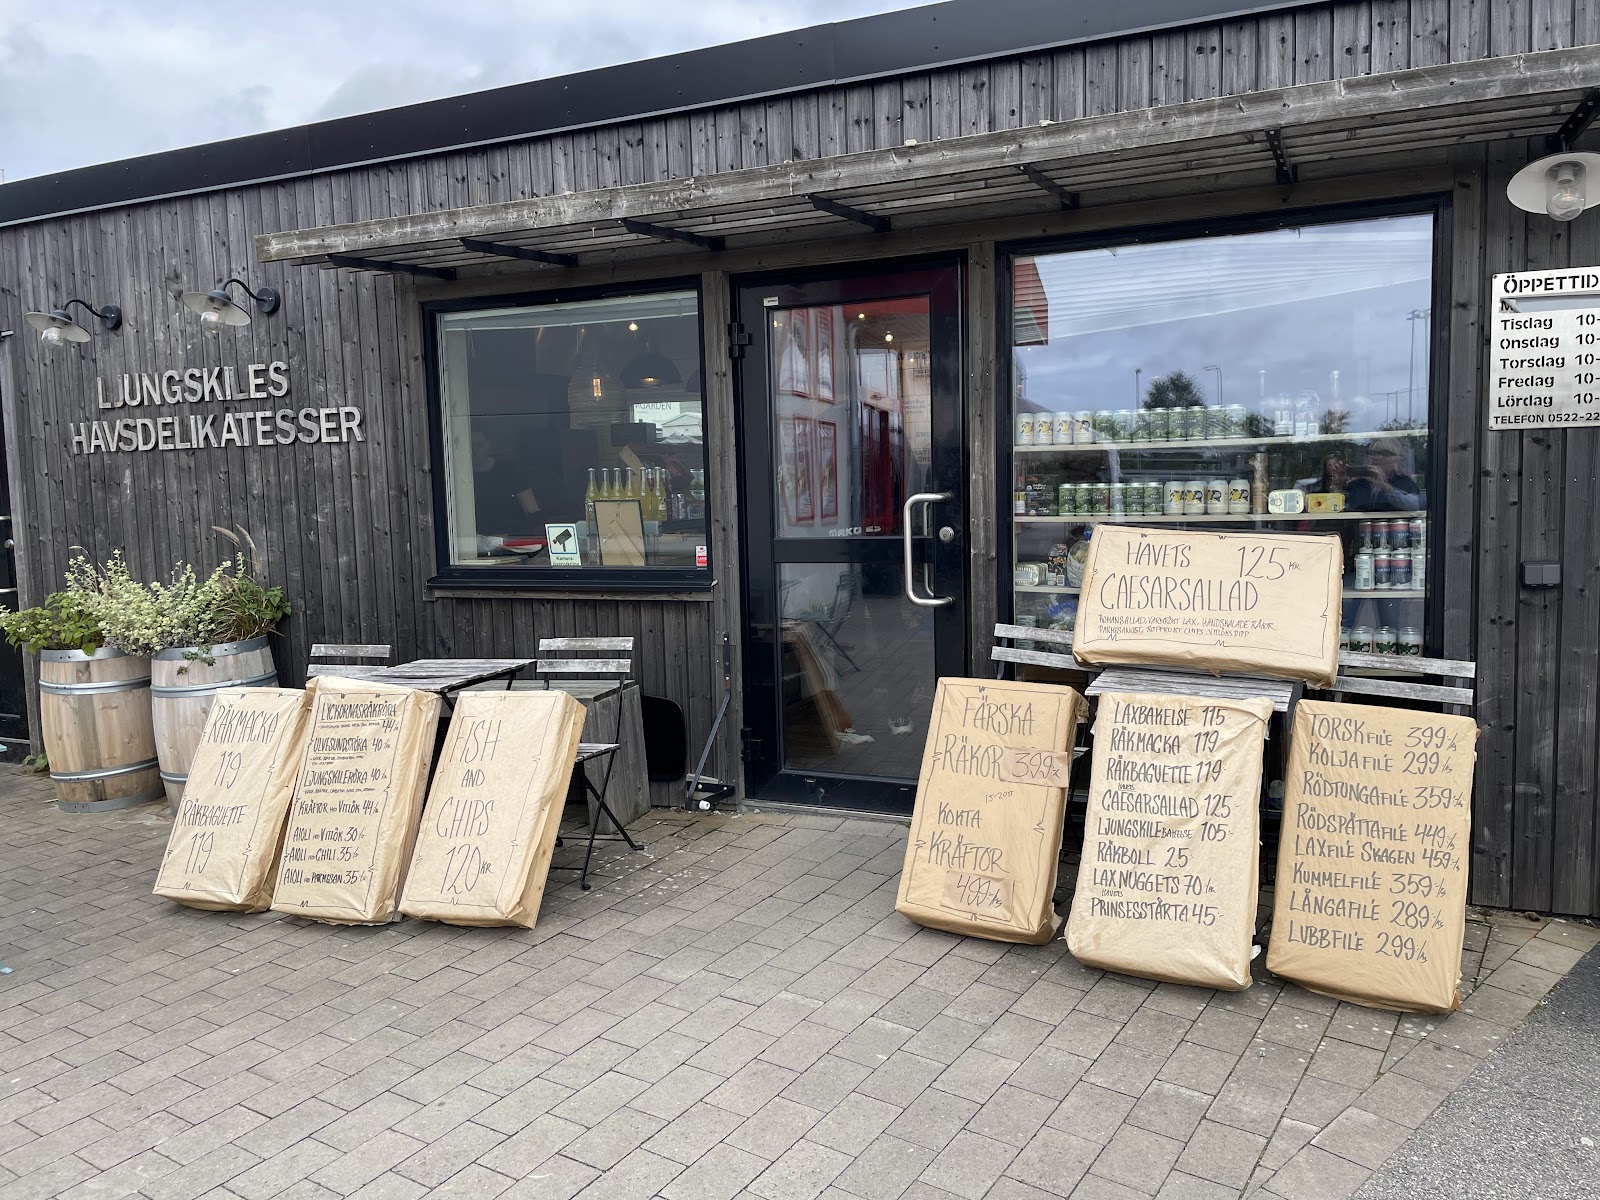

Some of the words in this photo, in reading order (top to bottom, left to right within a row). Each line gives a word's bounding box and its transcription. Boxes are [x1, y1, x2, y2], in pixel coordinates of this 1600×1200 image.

[1501, 318, 1553, 330] Tisdag
[1500, 336, 1559, 350] Onsdag
[1500, 356, 1565, 369] Torsdag
[96, 361, 290, 409] LJUNGSKILES
[1498, 376, 1554, 388] Fredag
[1498, 395, 1553, 408] Lördag
[71, 406, 366, 454] HAVSDELIKATESSER
[1493, 414, 1544, 424] TELEFON
[1127, 541, 1191, 568] HAVETS
[1100, 573, 1258, 612] CAESARSALLAD
[208, 704, 280, 744] RÄKMACKA
[962, 695, 1036, 736] FÄRSKA
[1114, 702, 1192, 726] LAXBAKELSE
[450, 716, 502, 763] FISH
[1110, 726, 1180, 755] RÄKMACKA
[214, 751, 242, 789] 119
[942, 734, 1004, 781] RÄKOR
[1106, 755, 1192, 784] RÄKBAGUETTE
[461, 768, 485, 788] AND
[181, 798, 248, 826] RÄKBAGUETTE
[436, 796, 494, 839] CHIPS
[938, 802, 983, 828] KOKTA
[1102, 789, 1199, 818] CAESARSALLAD
[293, 826, 312, 842] AIOLI
[185, 832, 214, 874] 119
[289, 846, 308, 862] AIOLI
[316, 848, 336, 862] CHILI
[928, 830, 1010, 874] KRÄFTOR
[1096, 840, 1156, 866] RÄKBOLL
[1360, 842, 1414, 864] SKAGEN
[284, 868, 304, 884] AIOLI
[1091, 897, 1188, 922] PRINSESSTÅRTA
[1290, 888, 1380, 920] LÅNGAFILÉ
[1288, 920, 1364, 952] LUBBFILÉ
